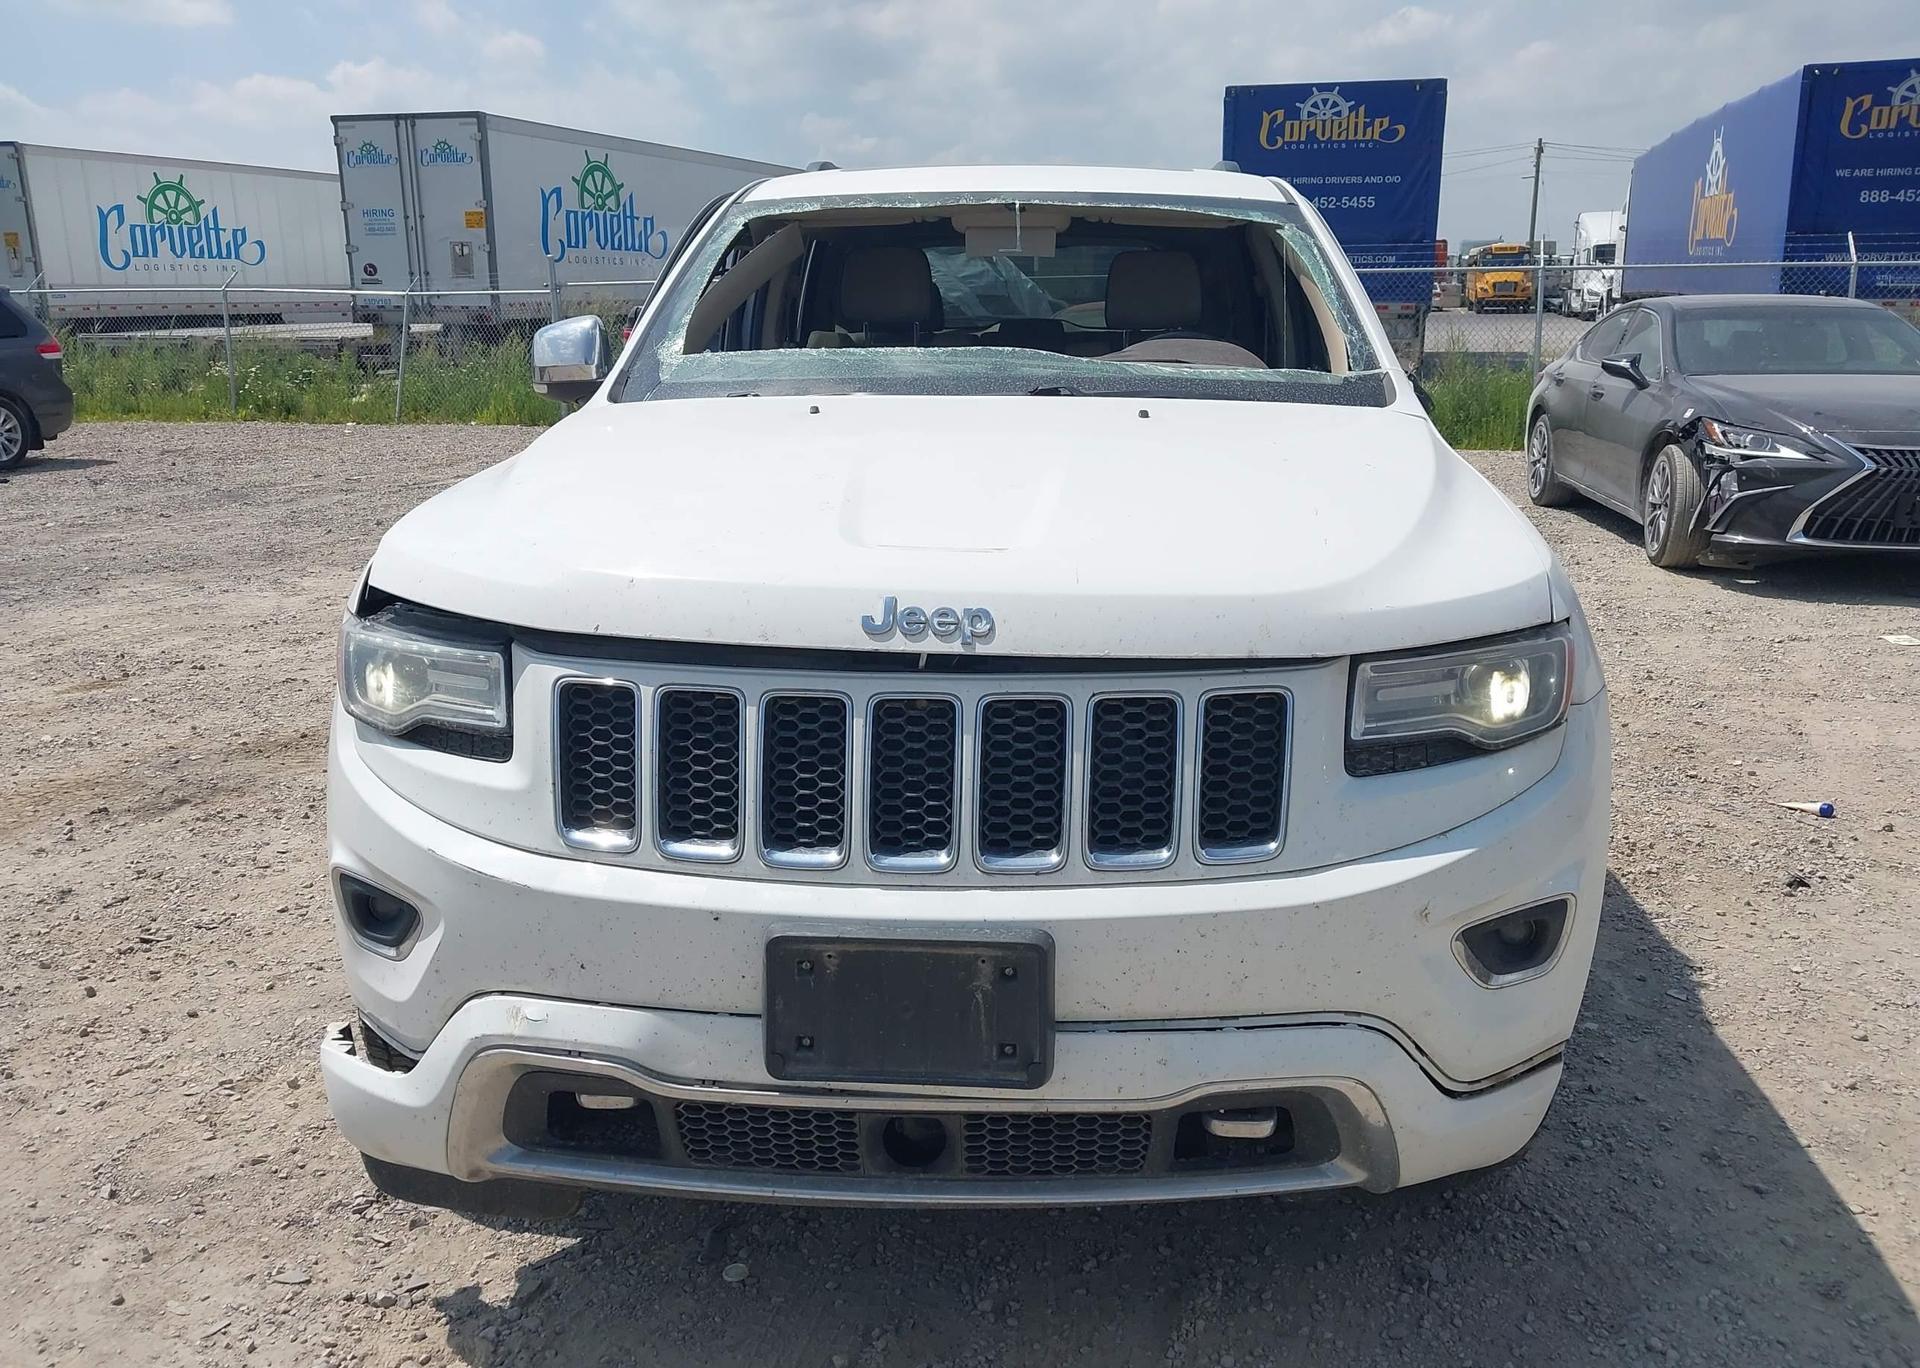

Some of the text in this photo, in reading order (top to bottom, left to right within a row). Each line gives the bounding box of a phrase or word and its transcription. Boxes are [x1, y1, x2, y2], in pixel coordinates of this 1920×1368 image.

[1259, 104, 1406, 149] Corvette
[1284, 142, 1347, 150] LOGISTICS
[346, 148, 399, 169] Corvette
[420, 146, 474, 167] Corvette
[1835, 168, 1852, 177] WE
[1853, 168, 1874, 177] ARE
[1876, 167, 1912, 177] HIRING
[1293, 175, 1324, 185] HIRING
[1325, 175, 1364, 184] DRIVERS
[1364, 175, 1384, 184] AND
[1385, 175, 1402, 184] O/O
[362, 208, 395, 218] HIRING
[540, 186, 668, 263] Corvette
[96, 203, 266, 271] Corvette
[134, 263, 208, 272] LOGISTICS
[567, 256, 625, 266] LOGISTICS
[861, 596, 994, 646] Jeep
